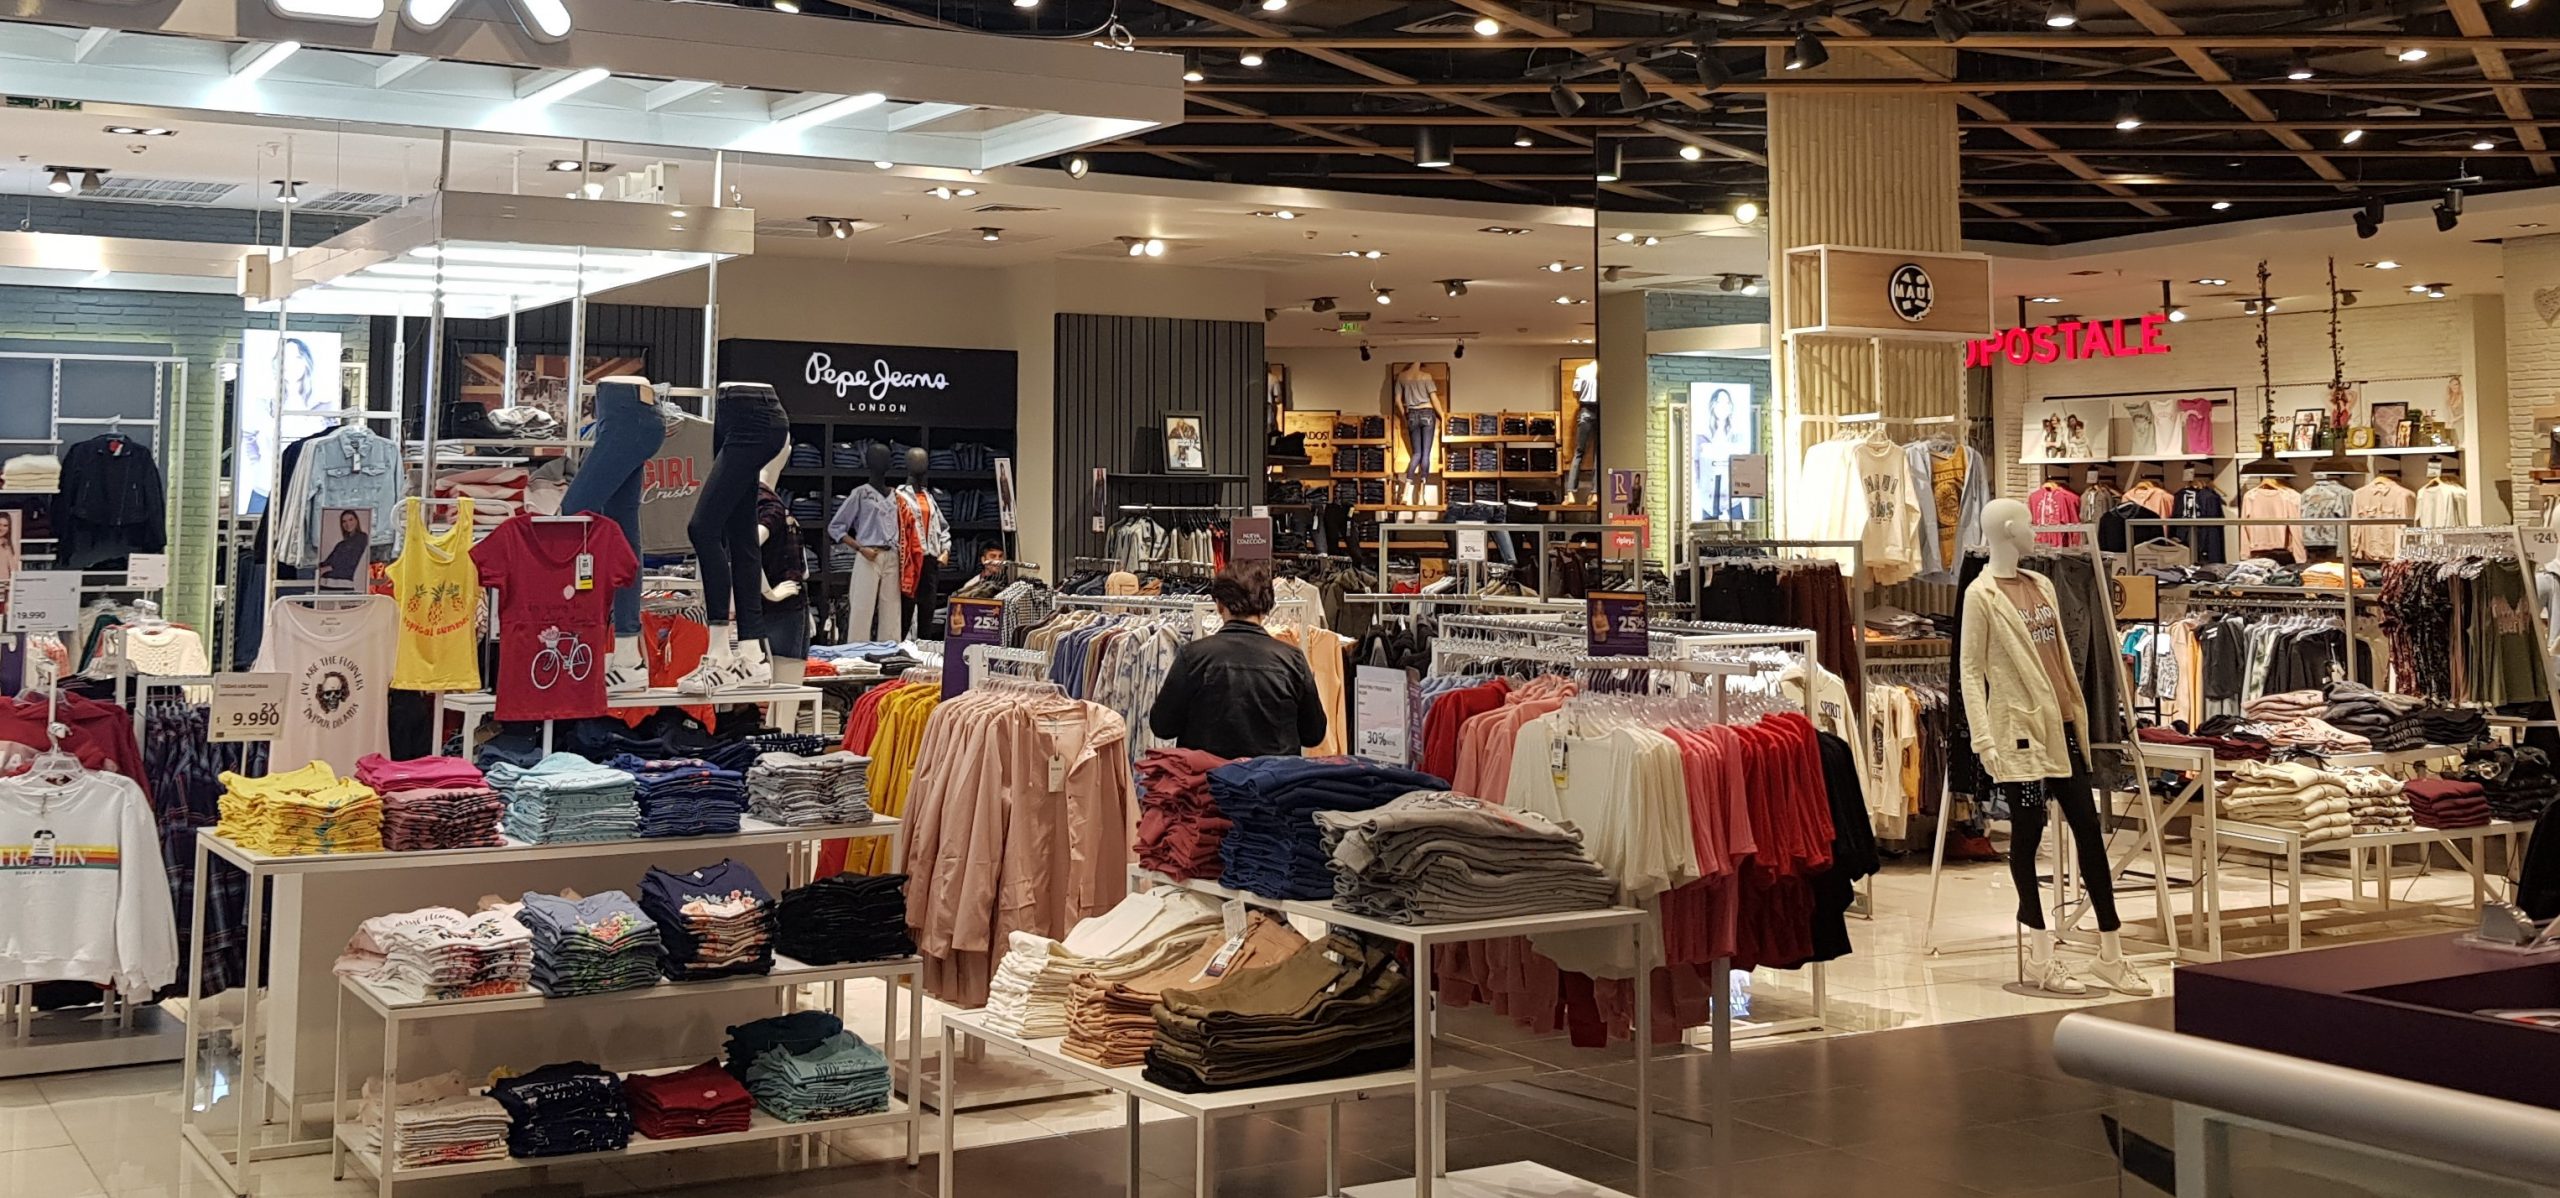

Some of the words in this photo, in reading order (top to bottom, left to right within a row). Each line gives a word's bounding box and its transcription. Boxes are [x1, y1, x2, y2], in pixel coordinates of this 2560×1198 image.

[1895, 283, 1932, 300] MAUI
[805, 351, 870, 398] Pepe
[869, 358, 949, 400] Jeans
[849, 402, 907, 413] LONDON
[643, 456, 703, 491] GIRL
[641, 480, 698, 504] Crush
[973, 615, 1000, 630] 25%
[1618, 615, 1646, 632] 25%
[320, 655, 338, 668] THE
[261, 702, 279, 714] 2X
[232, 711, 280, 726] 9.990
[1367, 731, 1387, 747] 30%
